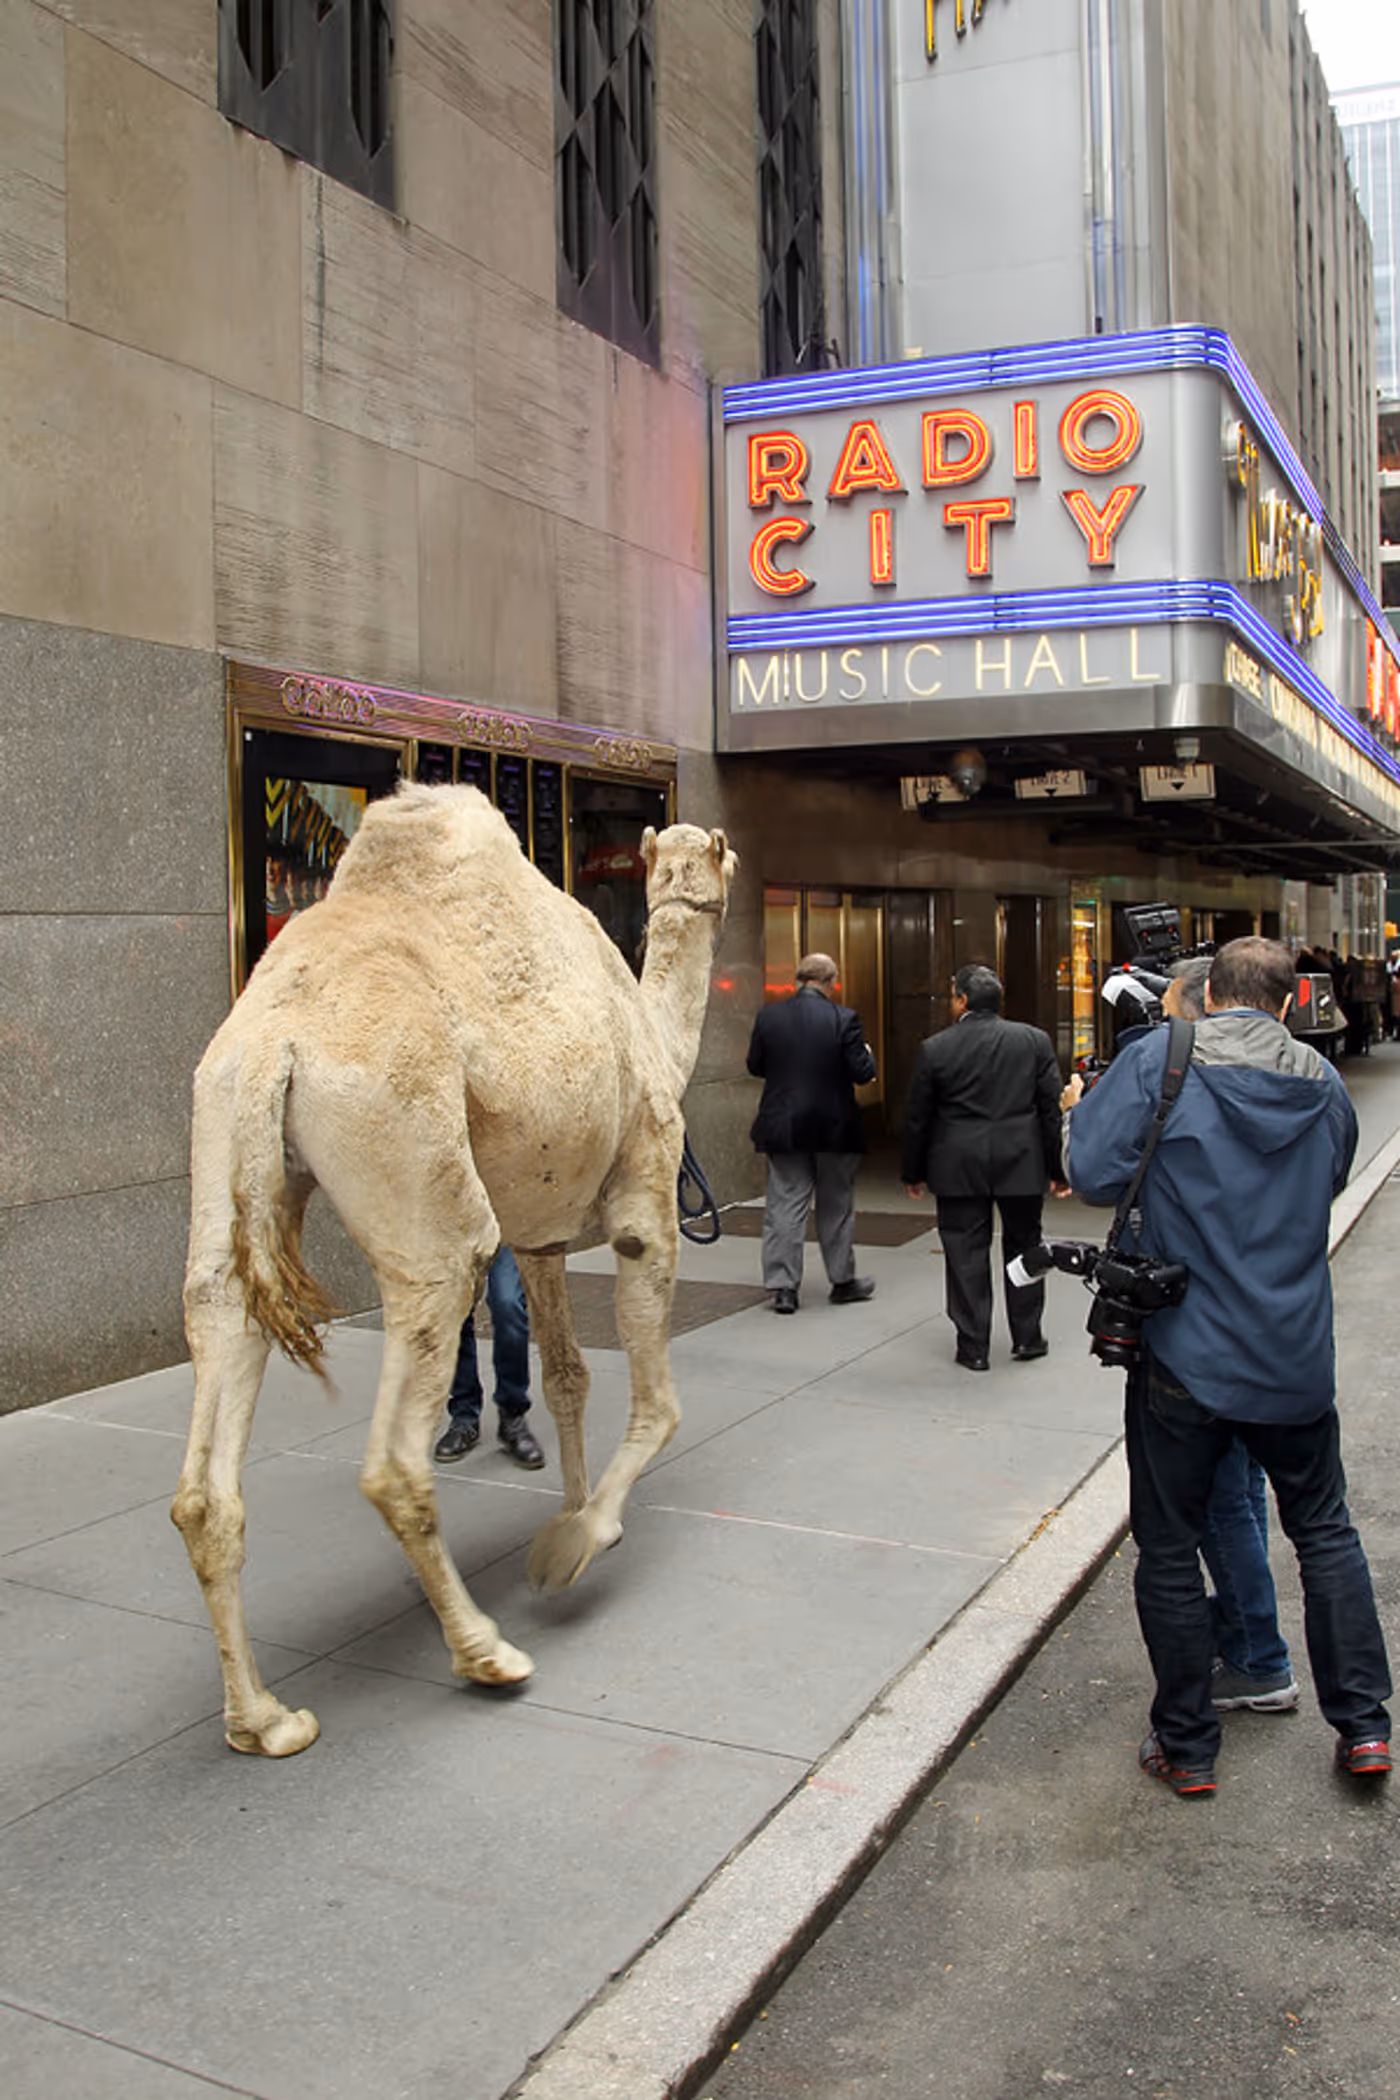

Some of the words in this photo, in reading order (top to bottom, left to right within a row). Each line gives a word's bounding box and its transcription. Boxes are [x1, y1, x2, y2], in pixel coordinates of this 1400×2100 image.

[748, 390, 1143, 508] RADIO
[748, 484, 1146, 596] CITY
[737, 642, 943, 706] MUSIC
[974, 627, 1162, 691] HALL
